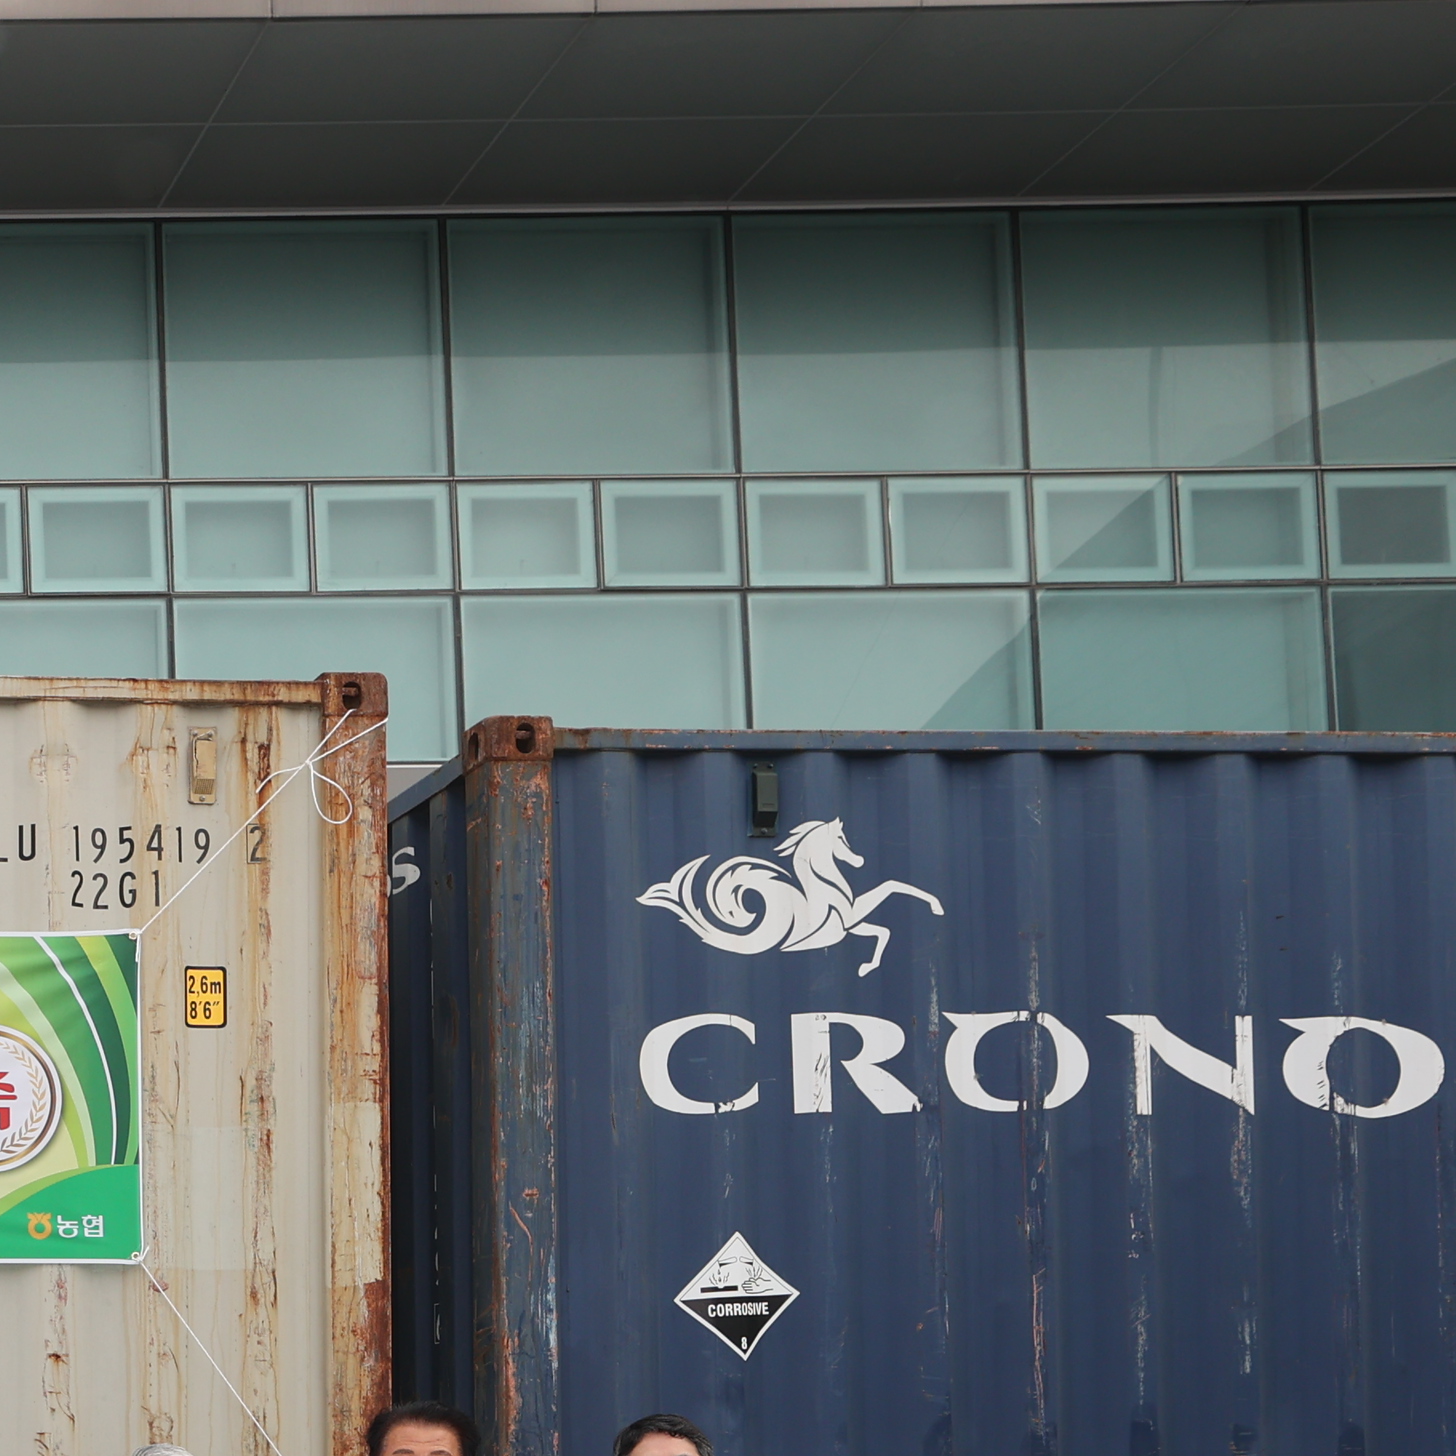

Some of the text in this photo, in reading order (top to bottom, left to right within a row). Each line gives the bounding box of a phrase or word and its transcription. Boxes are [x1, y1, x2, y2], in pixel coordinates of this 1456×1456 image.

[72, 823, 212, 864] 195419
[70, 869, 162, 909] 22G1
[638, 1010, 1446, 1119] CRONO
[56, 1214, 105, 1238] 농협
[707, 1302, 770, 1318] CORROSIVE
[741, 1336, 748, 1350] 8
